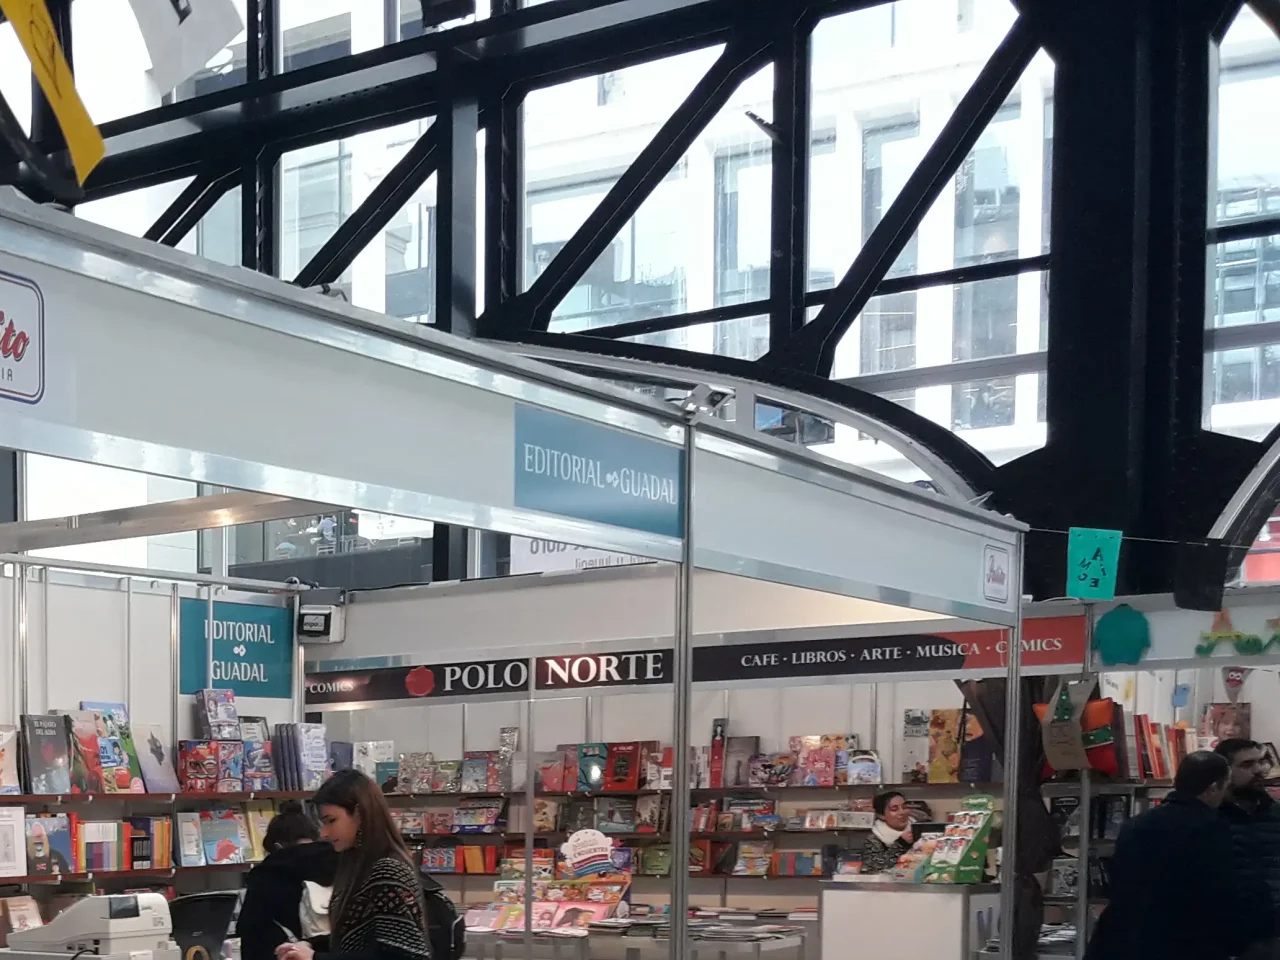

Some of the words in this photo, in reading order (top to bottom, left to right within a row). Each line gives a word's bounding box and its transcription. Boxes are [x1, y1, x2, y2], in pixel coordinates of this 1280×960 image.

[523, 442, 605, 489] EDITORIAL
[620, 467, 678, 505] GUADAL
[740, 653, 780, 668] CAFE
[791, 650, 847, 666] LIBROS
[859, 646, 903, 662] ARTE
[915, 642, 981, 660] MUSICA
[995, 637, 1063, 654] CMICS
[210, 660, 269, 683] GUADAL
[310, 679, 355, 694] COMICS
[442, 660, 529, 692] POLO
[544, 652, 664, 686] NORTE
